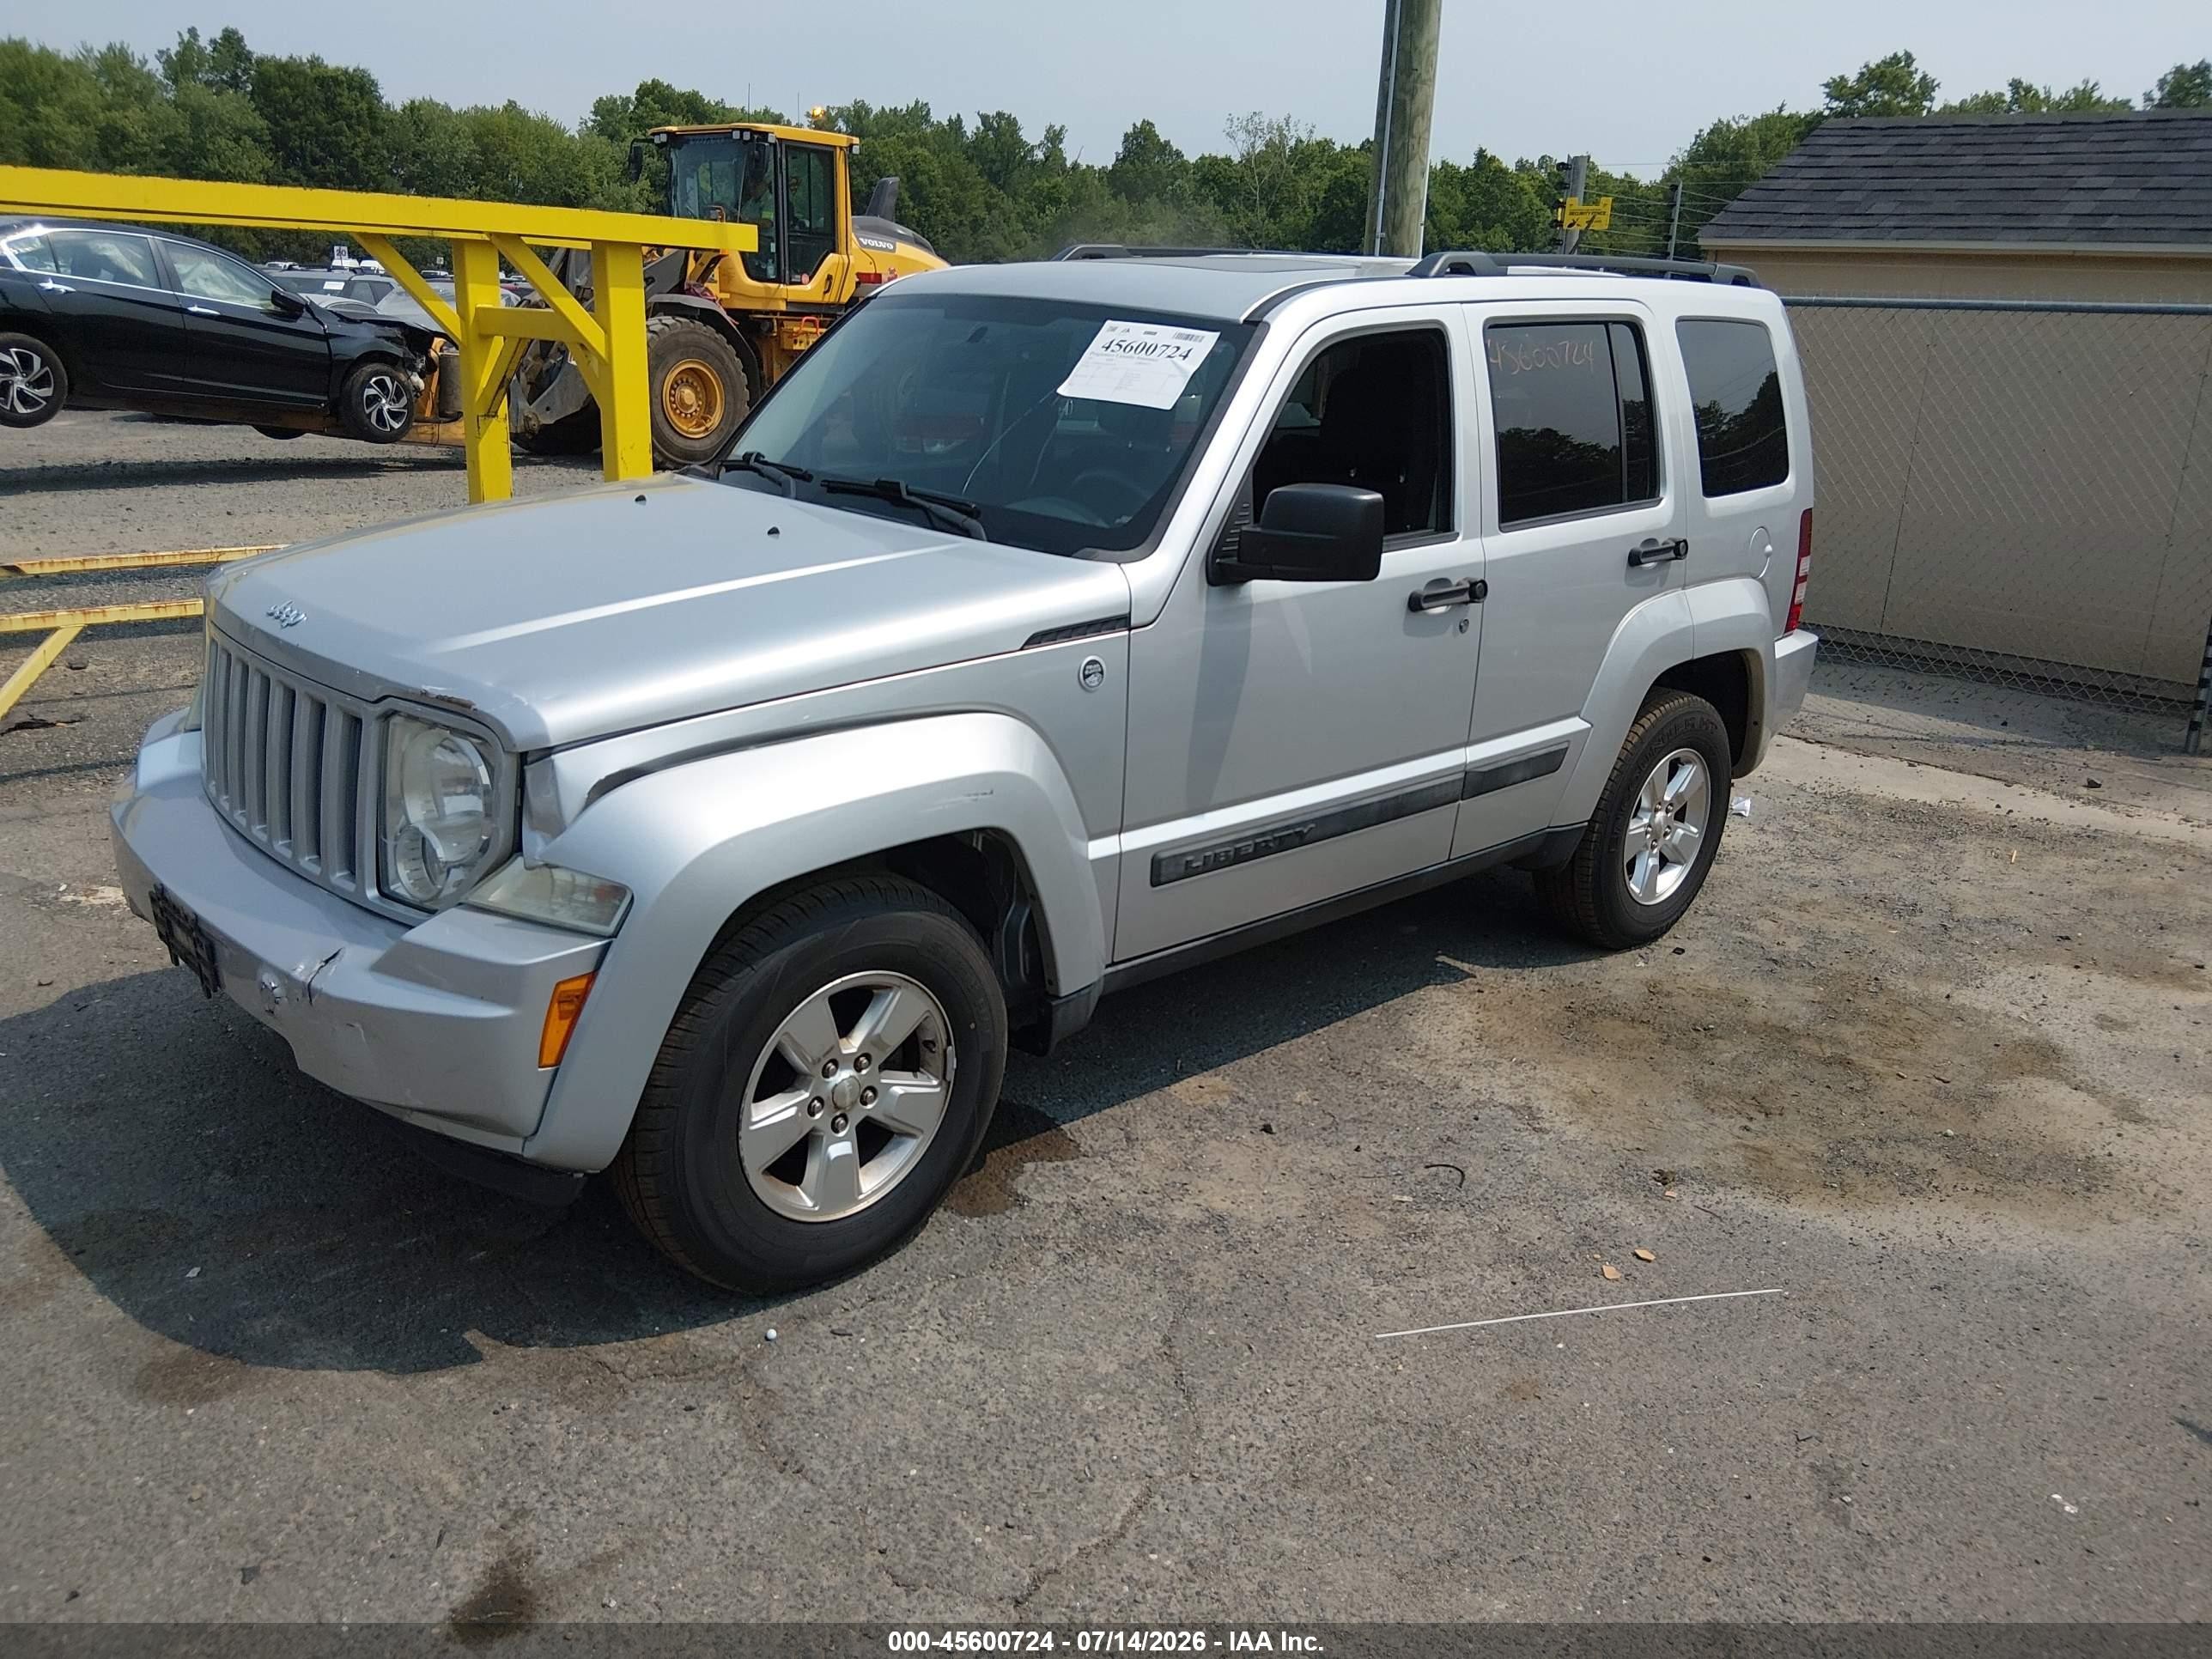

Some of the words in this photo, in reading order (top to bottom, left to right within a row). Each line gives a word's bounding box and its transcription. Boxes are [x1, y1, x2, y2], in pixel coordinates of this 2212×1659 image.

[859, 237, 894, 250] VOLVO
[1102, 338, 1194, 361] 45600724
[1487, 338, 1595, 375] 45600724
[1183, 823, 1316, 872] LIBERTY
